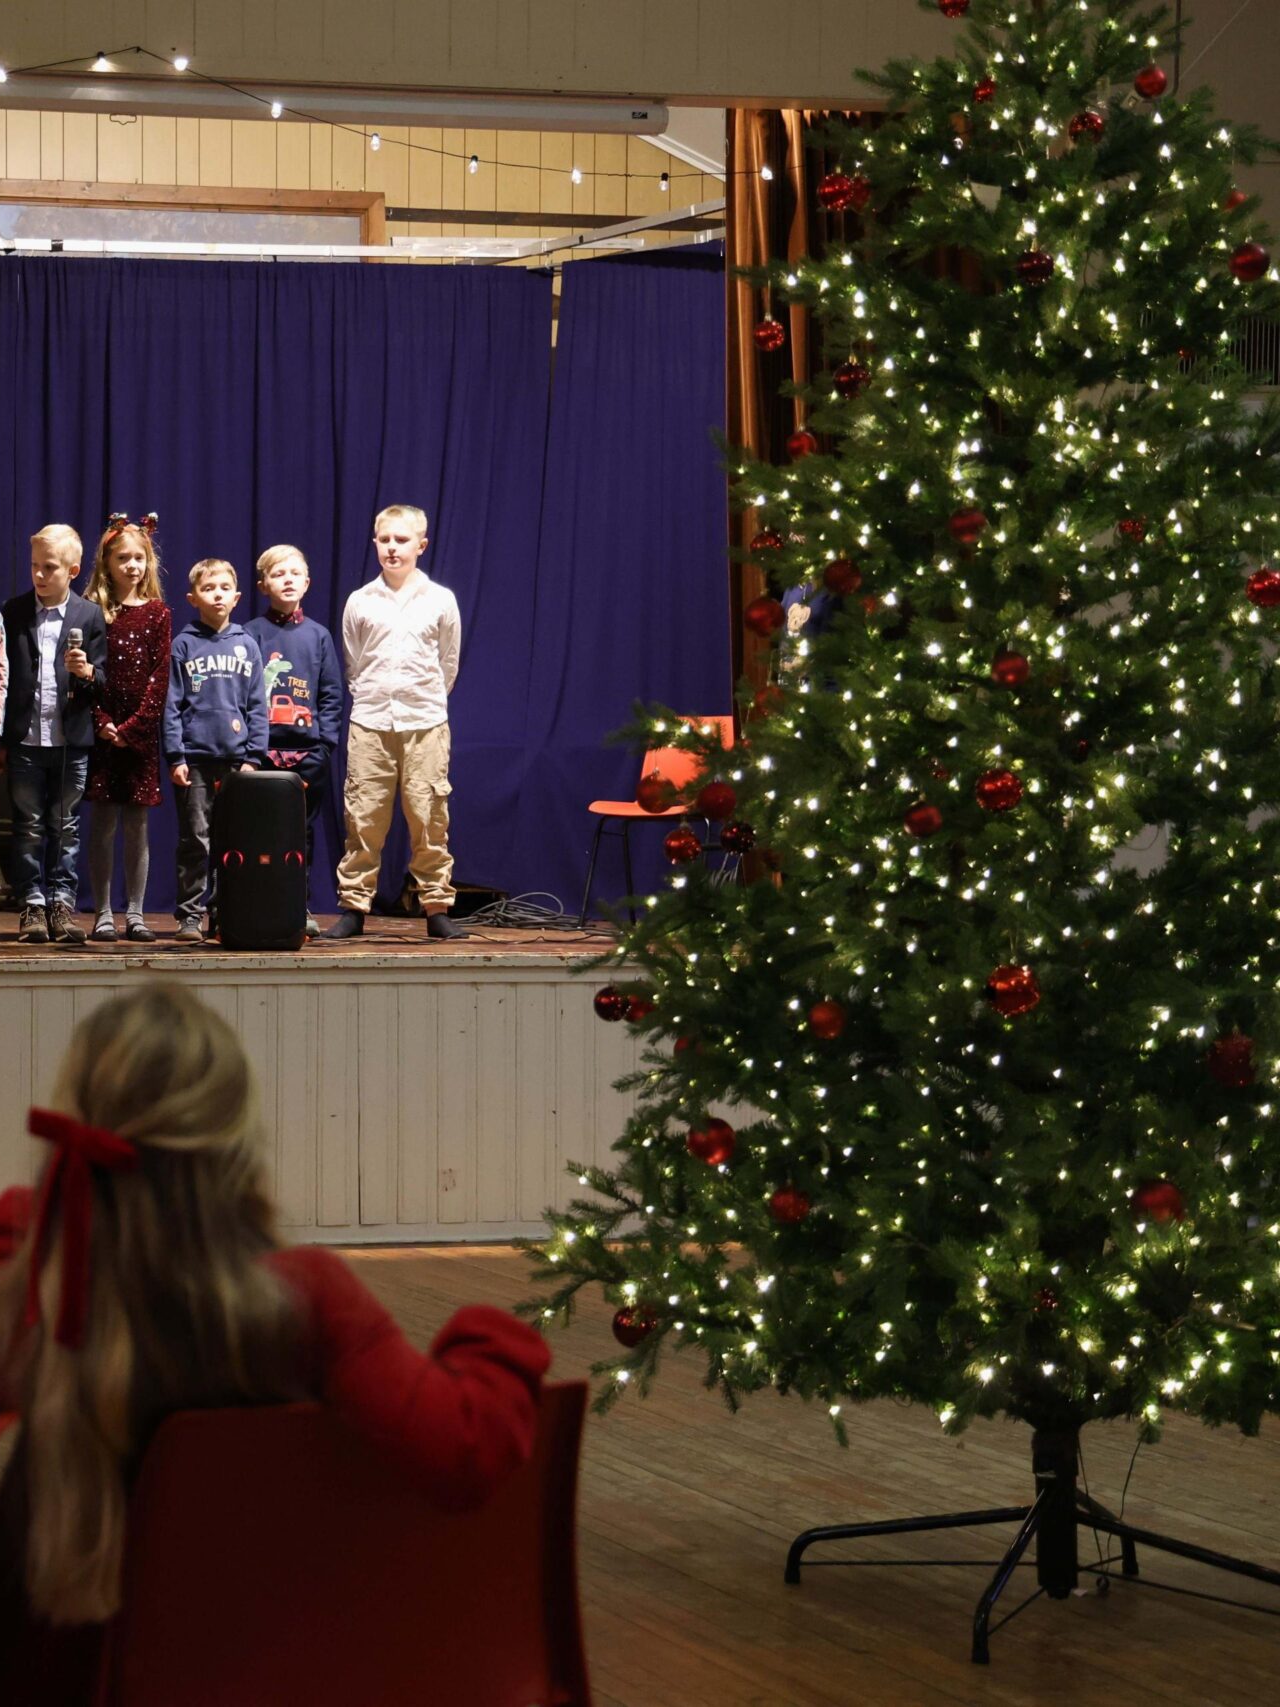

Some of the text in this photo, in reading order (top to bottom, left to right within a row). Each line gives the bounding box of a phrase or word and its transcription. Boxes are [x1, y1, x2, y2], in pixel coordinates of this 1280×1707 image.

[185, 655, 253, 677] PEANUTS
[287, 676, 308, 688] TREE
[293, 687, 310, 700] REX
